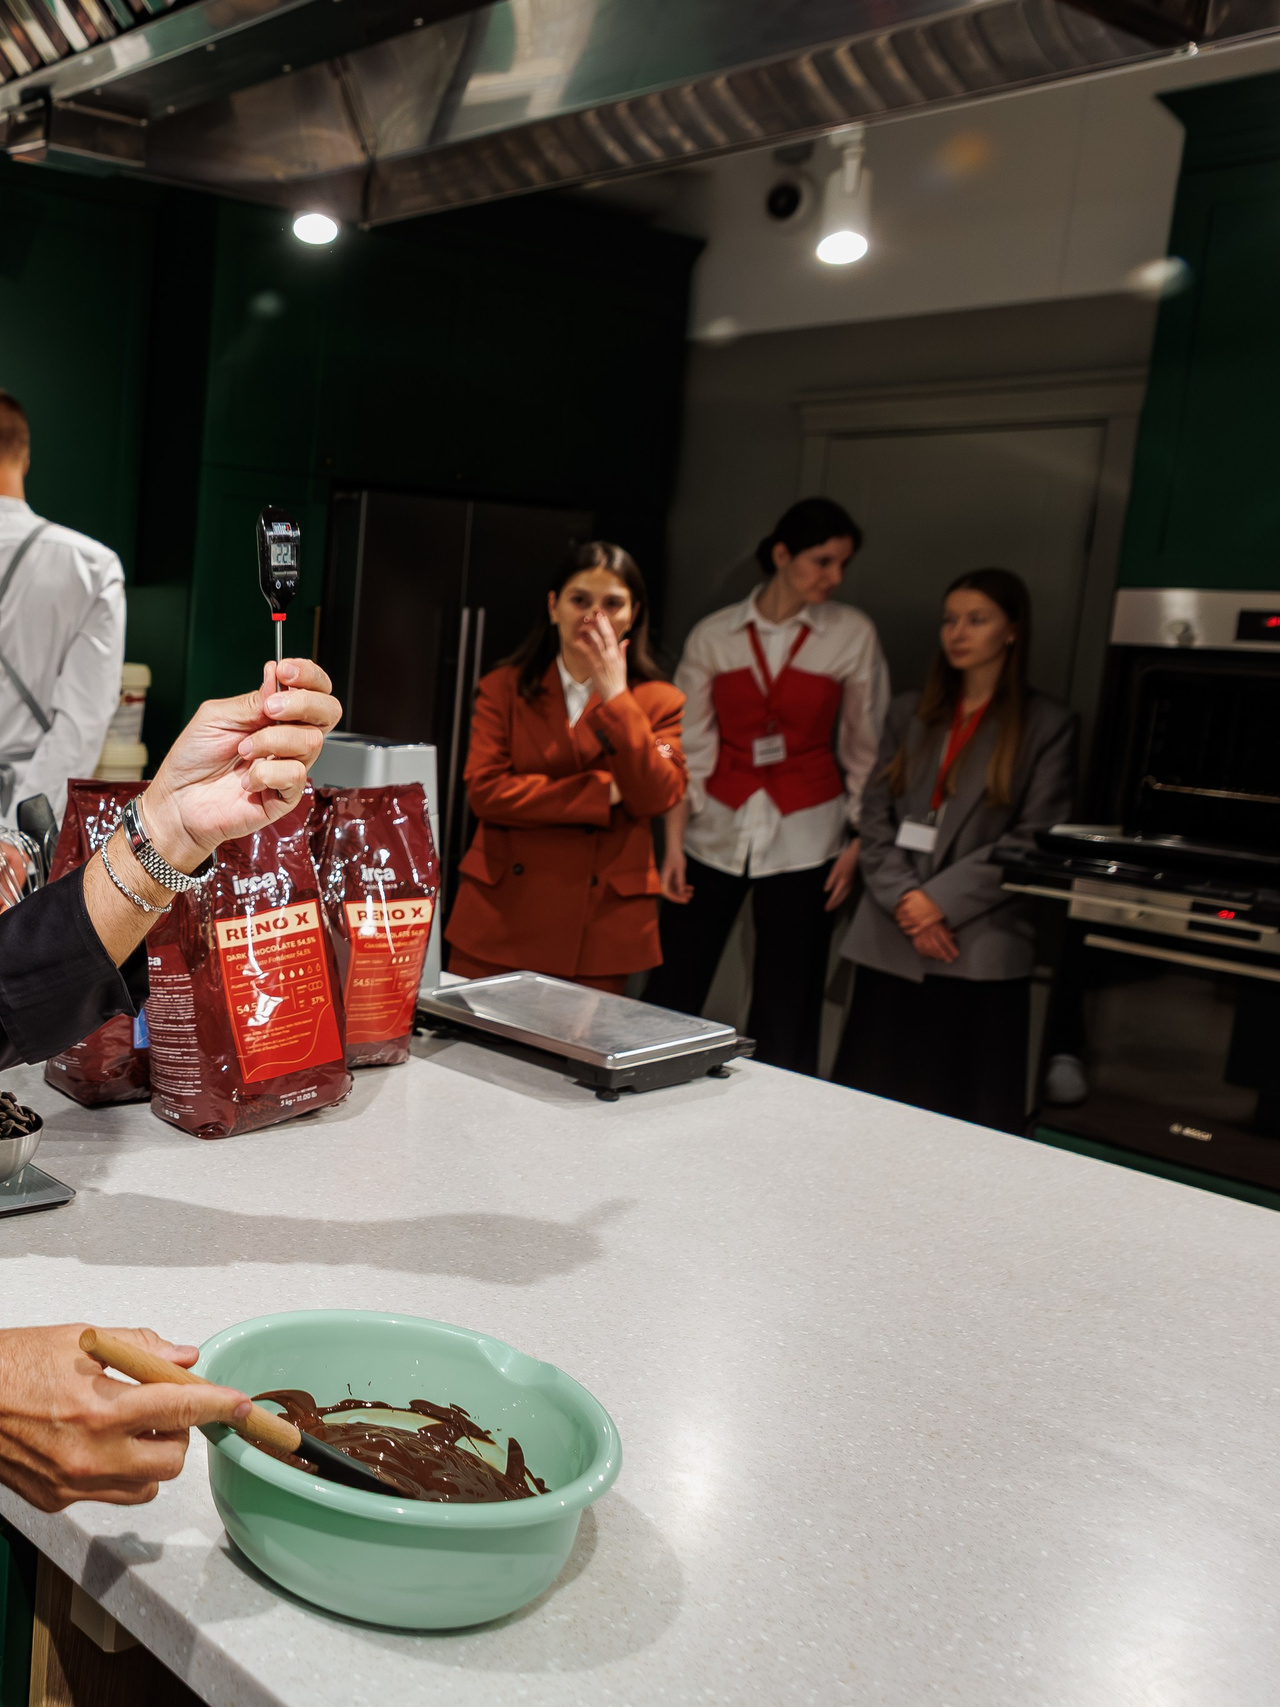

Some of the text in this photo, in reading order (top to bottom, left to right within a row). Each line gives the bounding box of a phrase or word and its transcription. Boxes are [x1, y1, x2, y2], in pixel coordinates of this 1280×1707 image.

[360, 863, 396, 882] irca
[231, 871, 278, 896] irca
[411, 906, 424, 918] X
[225, 911, 310, 942] RENO X
[226, 952, 247, 962] DARK
[250, 941, 296, 957] HOCOLATE
